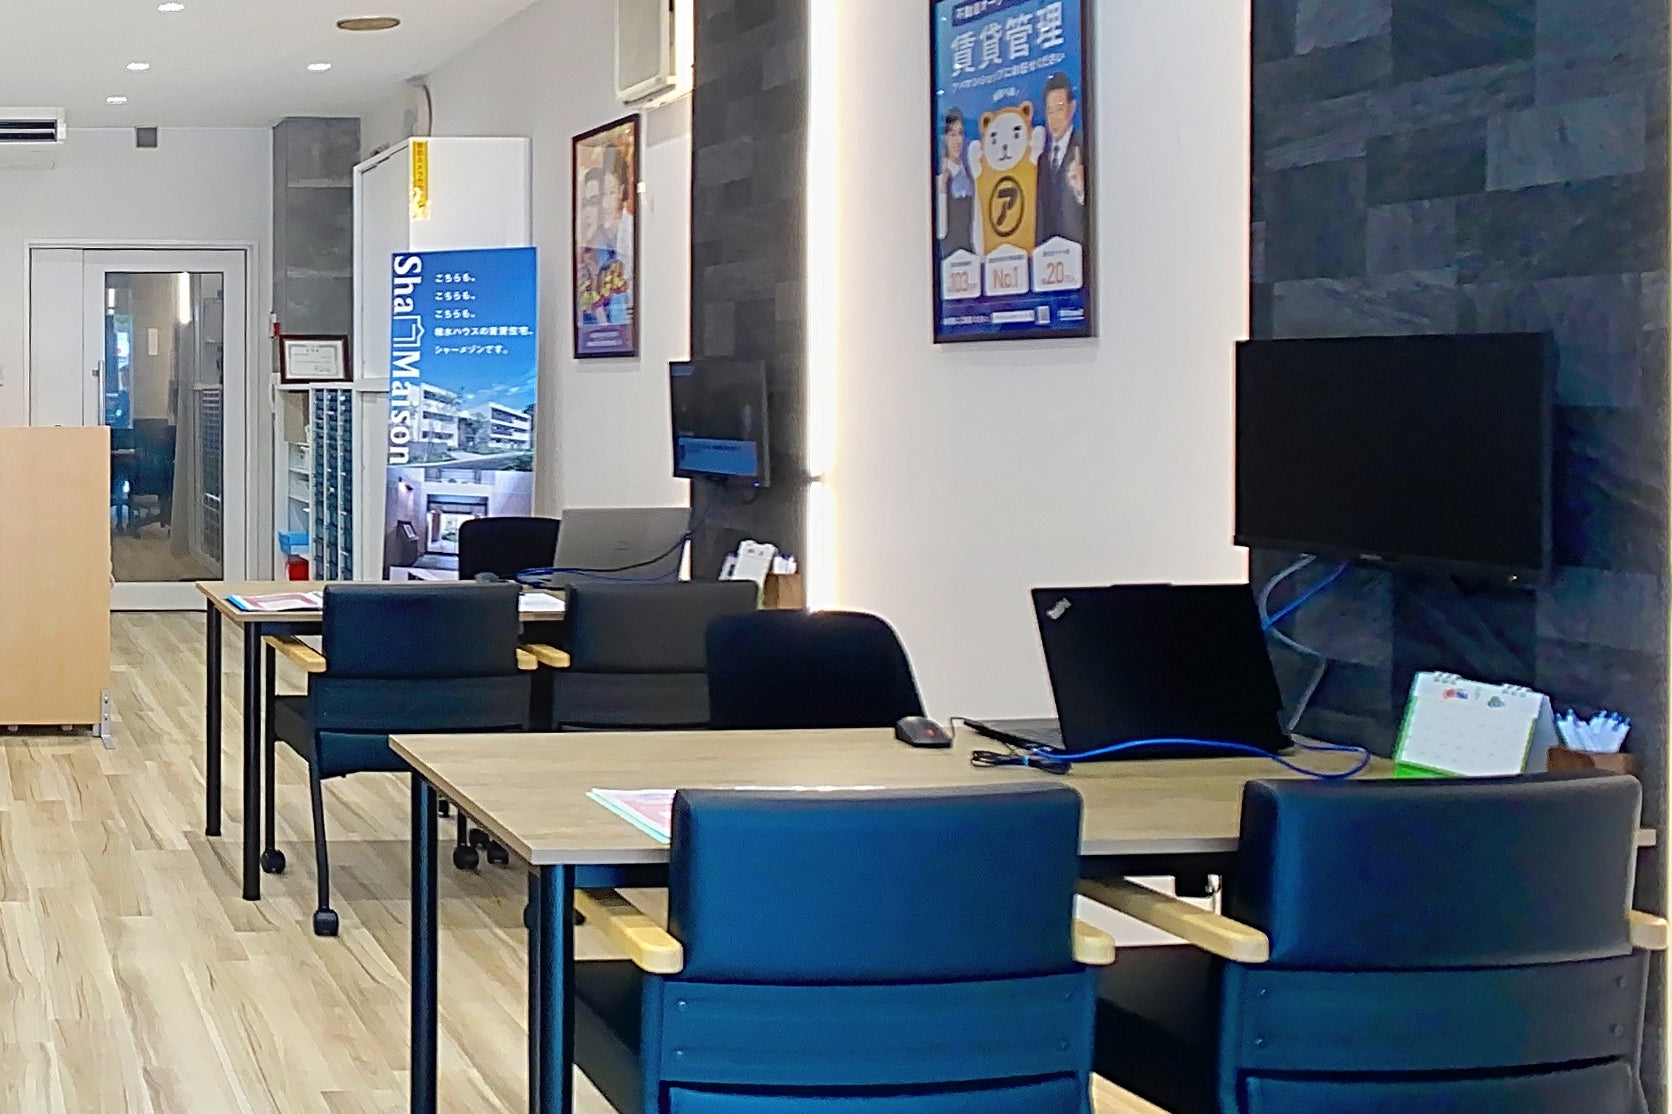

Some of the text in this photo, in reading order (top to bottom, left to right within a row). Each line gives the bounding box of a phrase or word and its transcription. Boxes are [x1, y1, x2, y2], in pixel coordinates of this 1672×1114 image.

[951, 1, 1064, 77] 賃貸管理
[995, 187, 1017, 227] ア
[389, 256, 422, 464] Sha Maison
